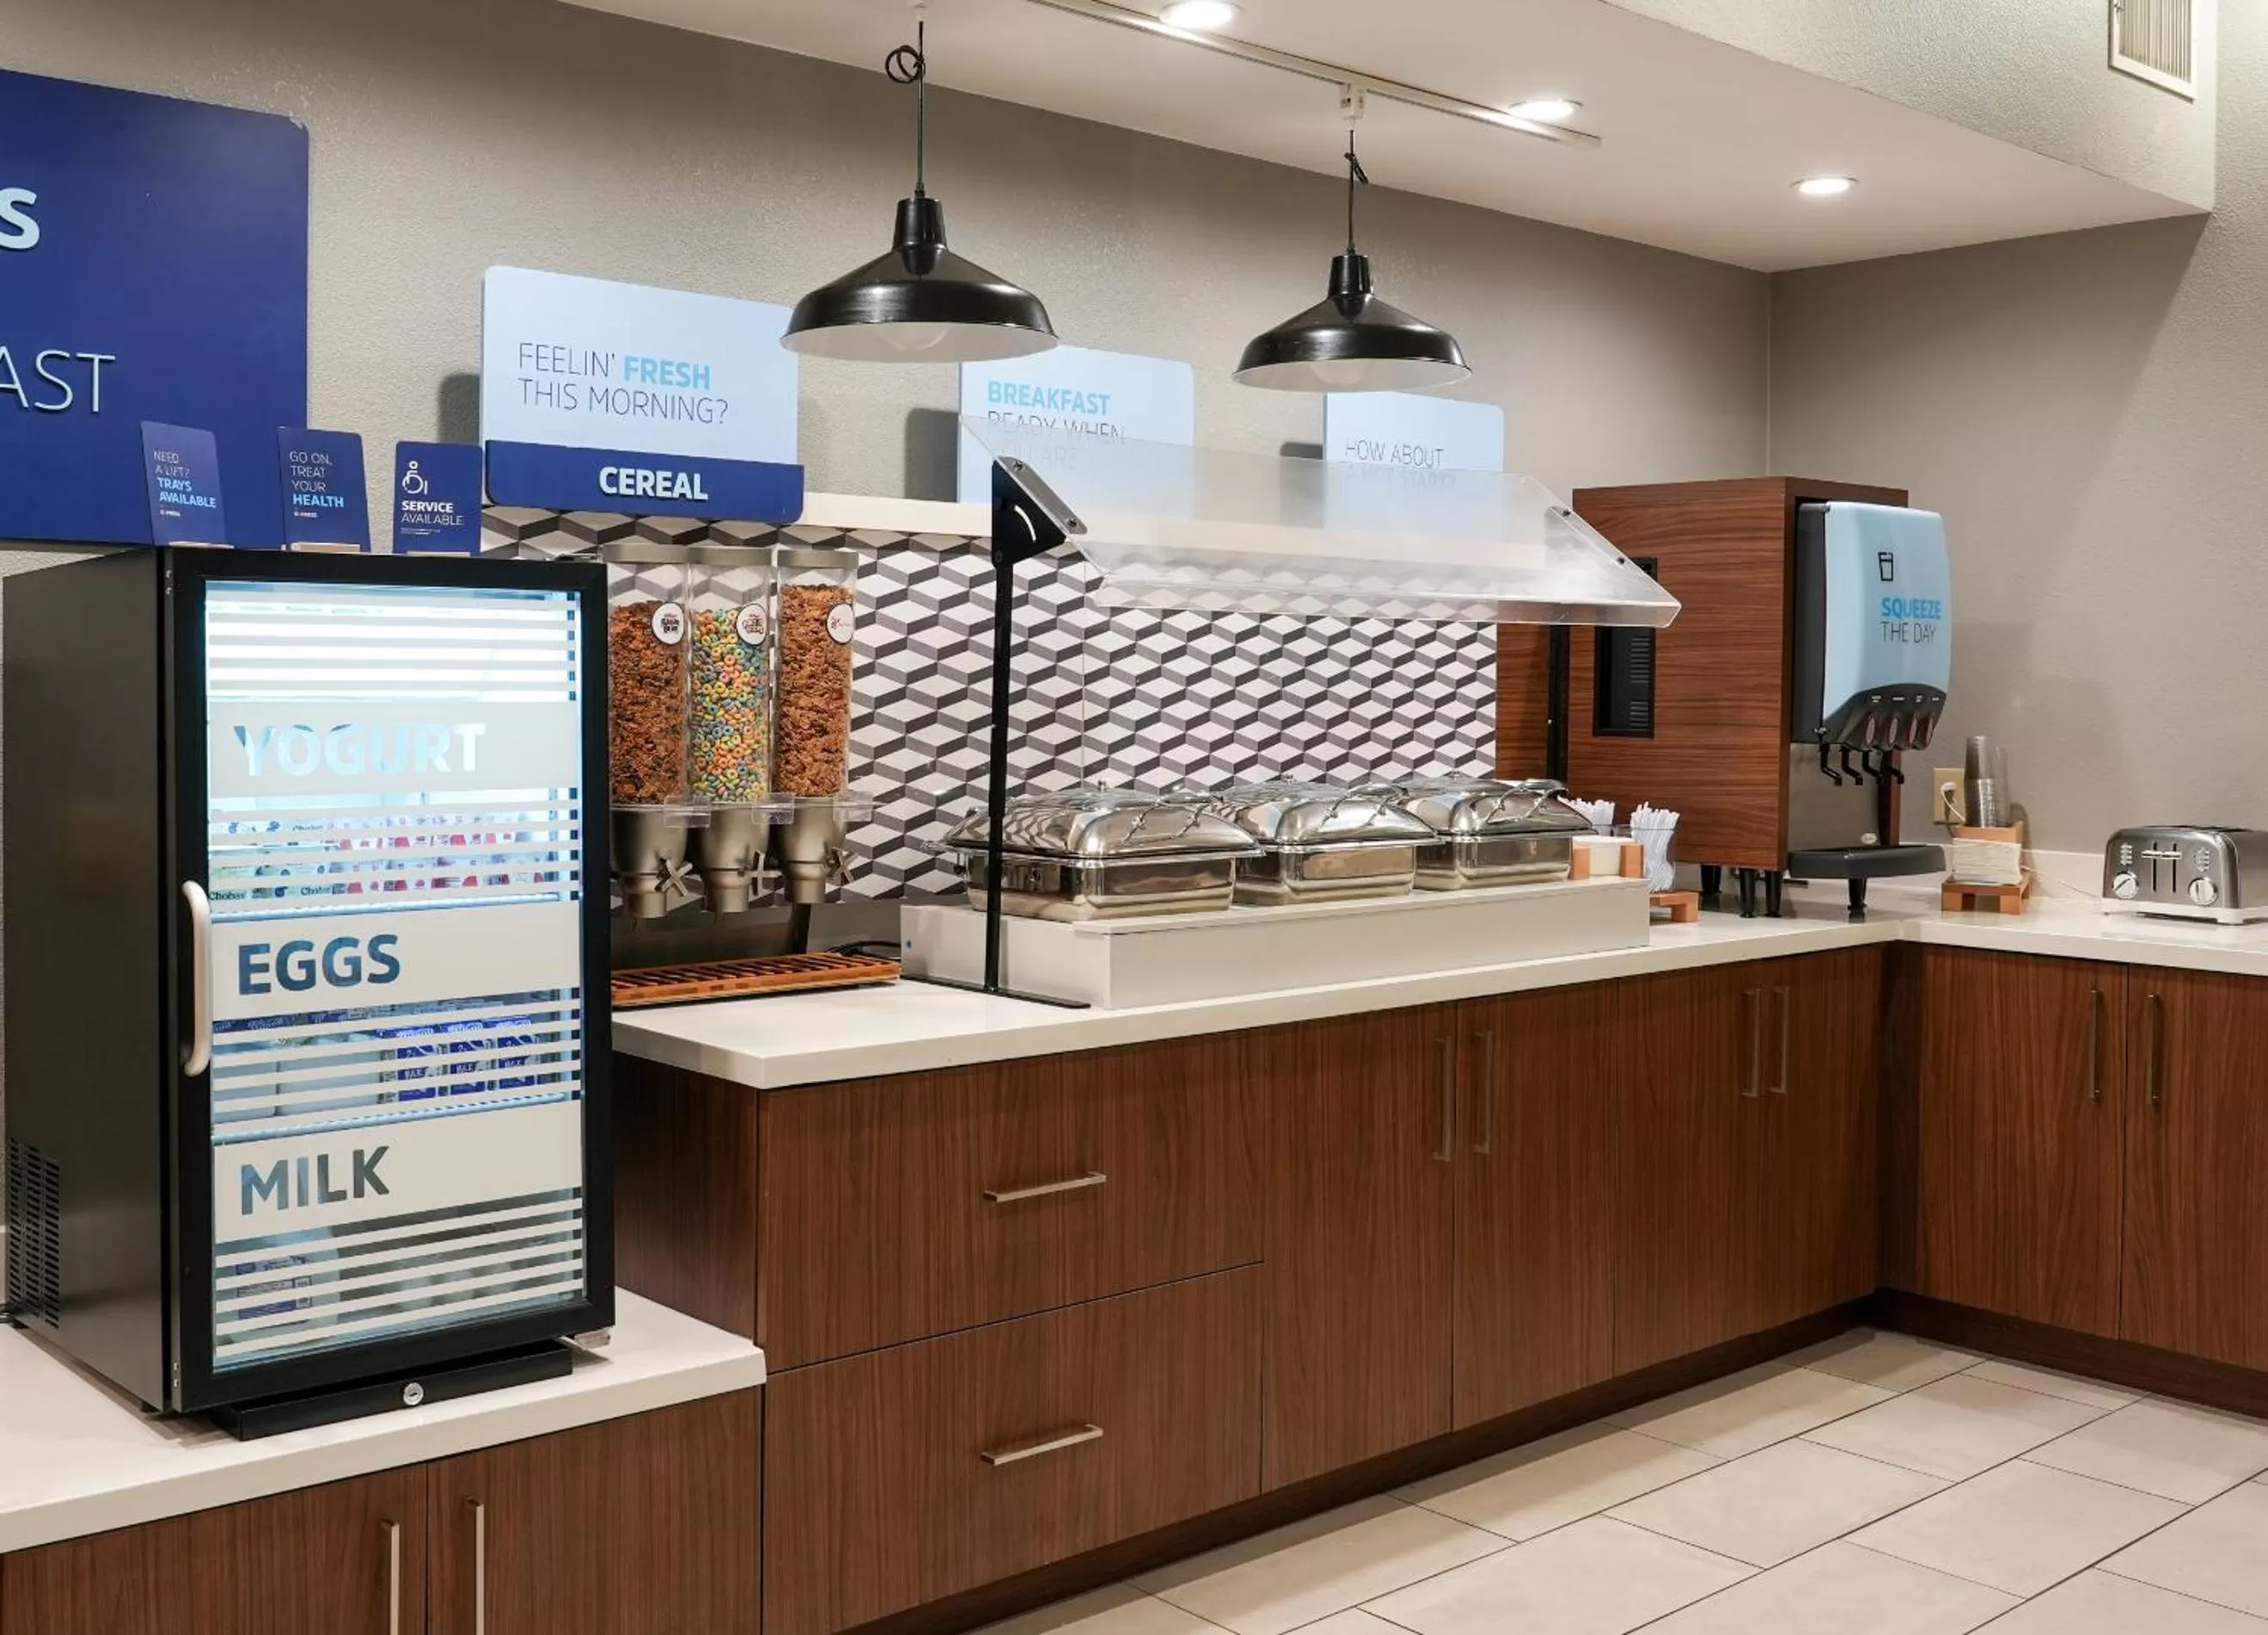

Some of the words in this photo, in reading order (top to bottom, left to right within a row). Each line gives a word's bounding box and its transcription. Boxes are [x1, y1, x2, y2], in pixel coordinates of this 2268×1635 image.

[518, 342, 616, 378] FEELIN'
[623, 355, 711, 390] FRESH
[517, 377, 578, 411] THIS
[589, 385, 729, 425] MORNING?
[987, 380, 1111, 416] BREAKFAST
[153, 450, 180, 464] NEED
[290, 450, 308, 464] GO
[1345, 437, 1385, 462] HOW
[1391, 443, 1445, 469] ABOUT
[290, 464, 326, 478] TREAT
[157, 476, 193, 493] TRAYS
[291, 479, 327, 493] YOUR
[599, 466, 709, 500] CEREAL
[159, 491, 218, 509] AVAILABLE
[292, 493, 345, 508] HEALTH
[401, 499, 455, 513] SERVICE
[400, 512, 466, 526] AVAILABLE
[1880, 597, 1942, 619] SQUEEZE
[1880, 621, 1910, 643] THE
[1913, 622, 1936, 644] DAY
[233, 723, 486, 777] YOGURT
[239, 934, 401, 996] EGGS
[241, 1145, 391, 1216] MILK
